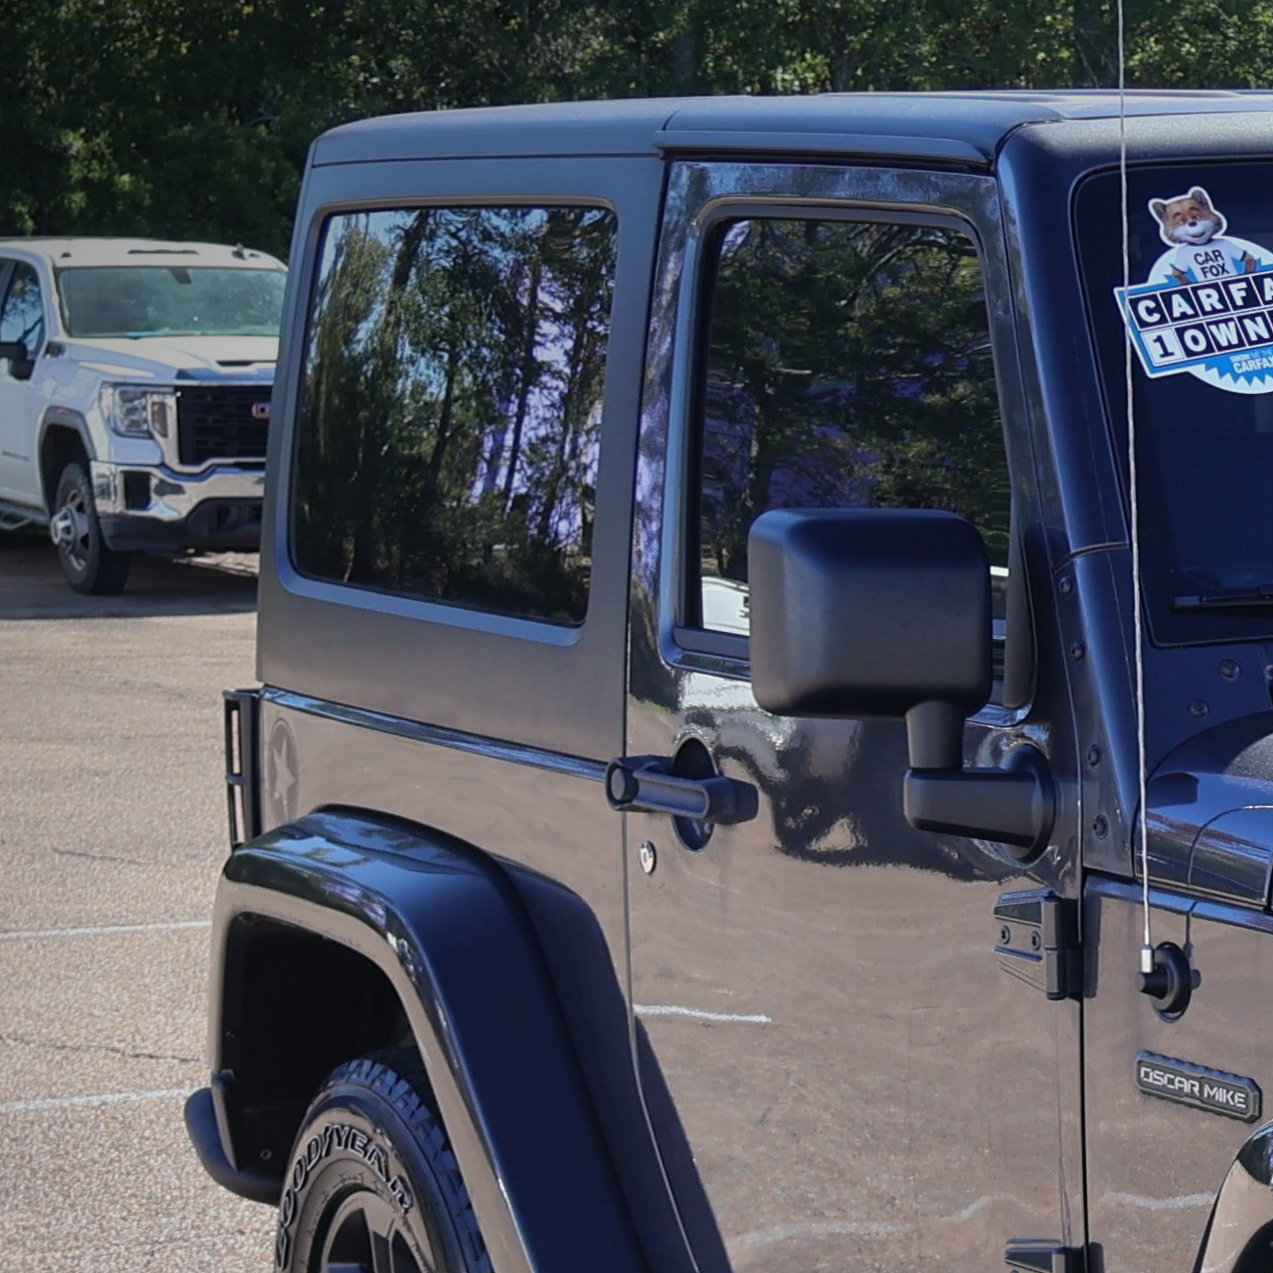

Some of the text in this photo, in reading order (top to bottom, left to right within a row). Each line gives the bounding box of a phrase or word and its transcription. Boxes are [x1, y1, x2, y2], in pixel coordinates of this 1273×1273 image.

[1193, 249, 1225, 266] CAR
[1200, 264, 1230, 280] FOX
[1152, 334, 1176, 359] 1
[1140, 1066, 1247, 1109] OSCAR MIKE
[274, 1122, 413, 1272] GOODYEAR
